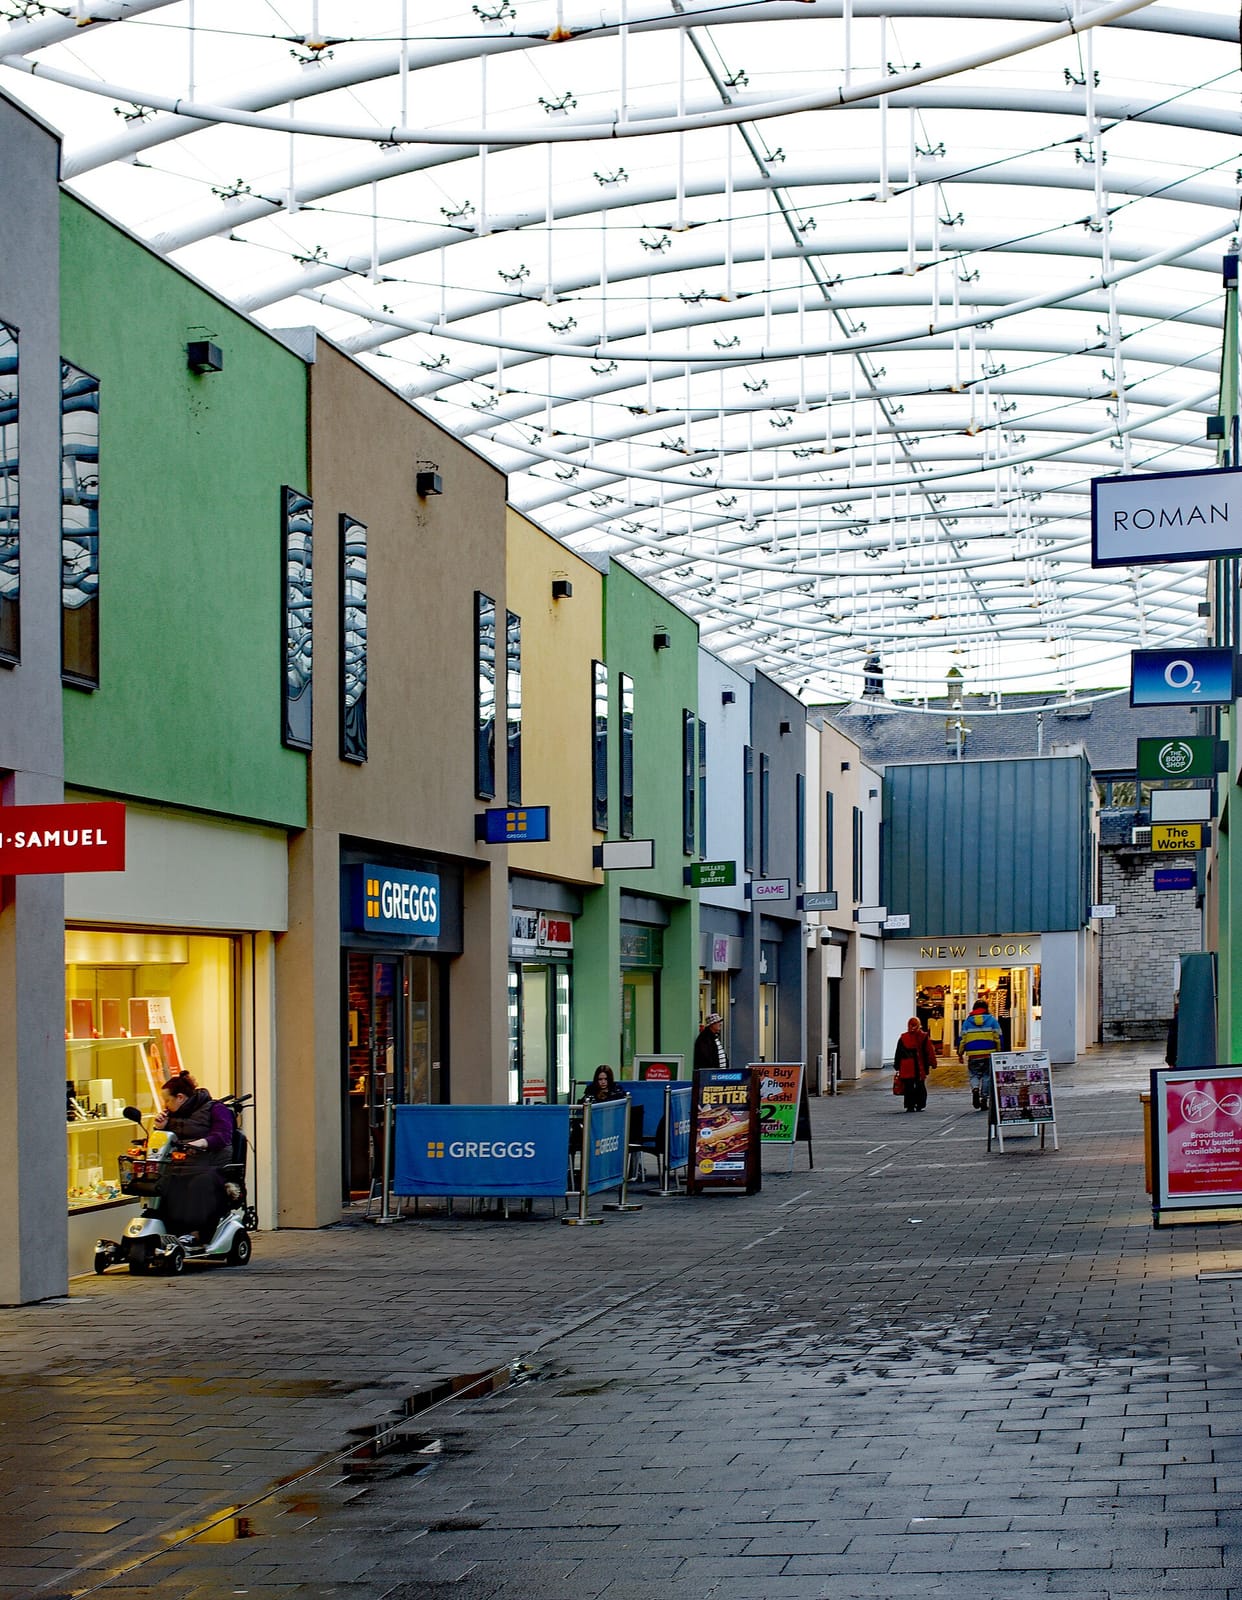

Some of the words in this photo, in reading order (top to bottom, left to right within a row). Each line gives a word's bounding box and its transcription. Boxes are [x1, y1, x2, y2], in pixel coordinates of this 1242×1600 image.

[1113, 502, 1229, 531] ROMAN
[1164, 659, 1202, 693] O2
[1166, 827, 1189, 838] The
[1157, 838, 1196, 849] Works
[699, 864, 727, 873] HOLLAND
[700, 876, 727, 884] BARRETT
[756, 885, 785, 895] GAME
[381, 880, 437, 923] GREGGS
[920, 945, 967, 958] NEW
[977, 943, 1032, 957] LOOK
[716, 1072, 743, 1080] GREGGS
[773, 1067, 794, 1079] Buy
[767, 1080, 796, 1089] Phone
[702, 1090, 747, 1105] BETTER
[766, 1093, 793, 1102] Cash!
[1185, 1096, 1212, 1118] Virgin
[758, 1104, 777, 1123] 2
[1190, 1130, 1234, 1139] Broadband
[600, 1134, 620, 1155] GREGGS
[1199, 1139, 1211, 1147] TV
[448, 1141, 536, 1158] GREGGS
[1184, 1147, 1221, 1156] available
[1222, 1146, 1241, 1154] here
